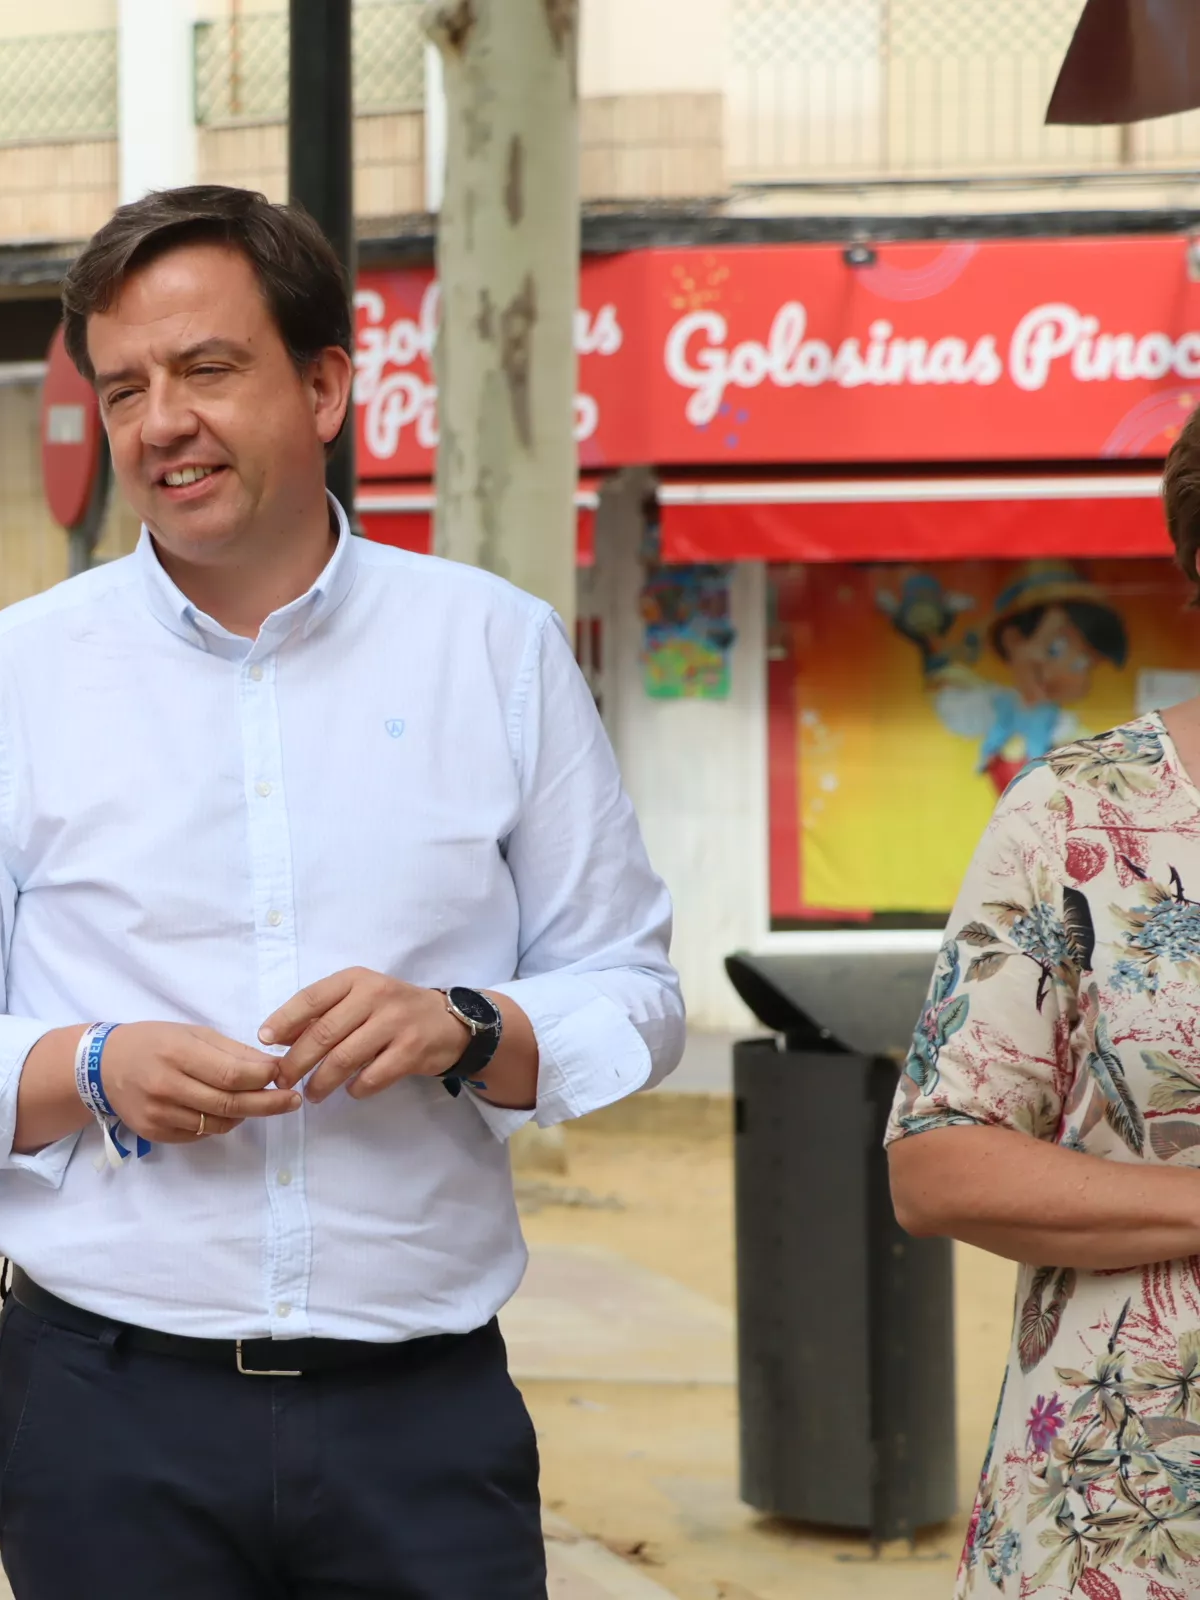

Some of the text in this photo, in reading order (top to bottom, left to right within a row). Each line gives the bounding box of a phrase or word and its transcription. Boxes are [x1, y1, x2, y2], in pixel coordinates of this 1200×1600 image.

[663, 301, 1003, 426] Golosinas
[90, 1039, 102, 1054] EL
[80, 1046, 89, 1094] ENTRE TODOS
[88, 1055, 99, 1071] ES
